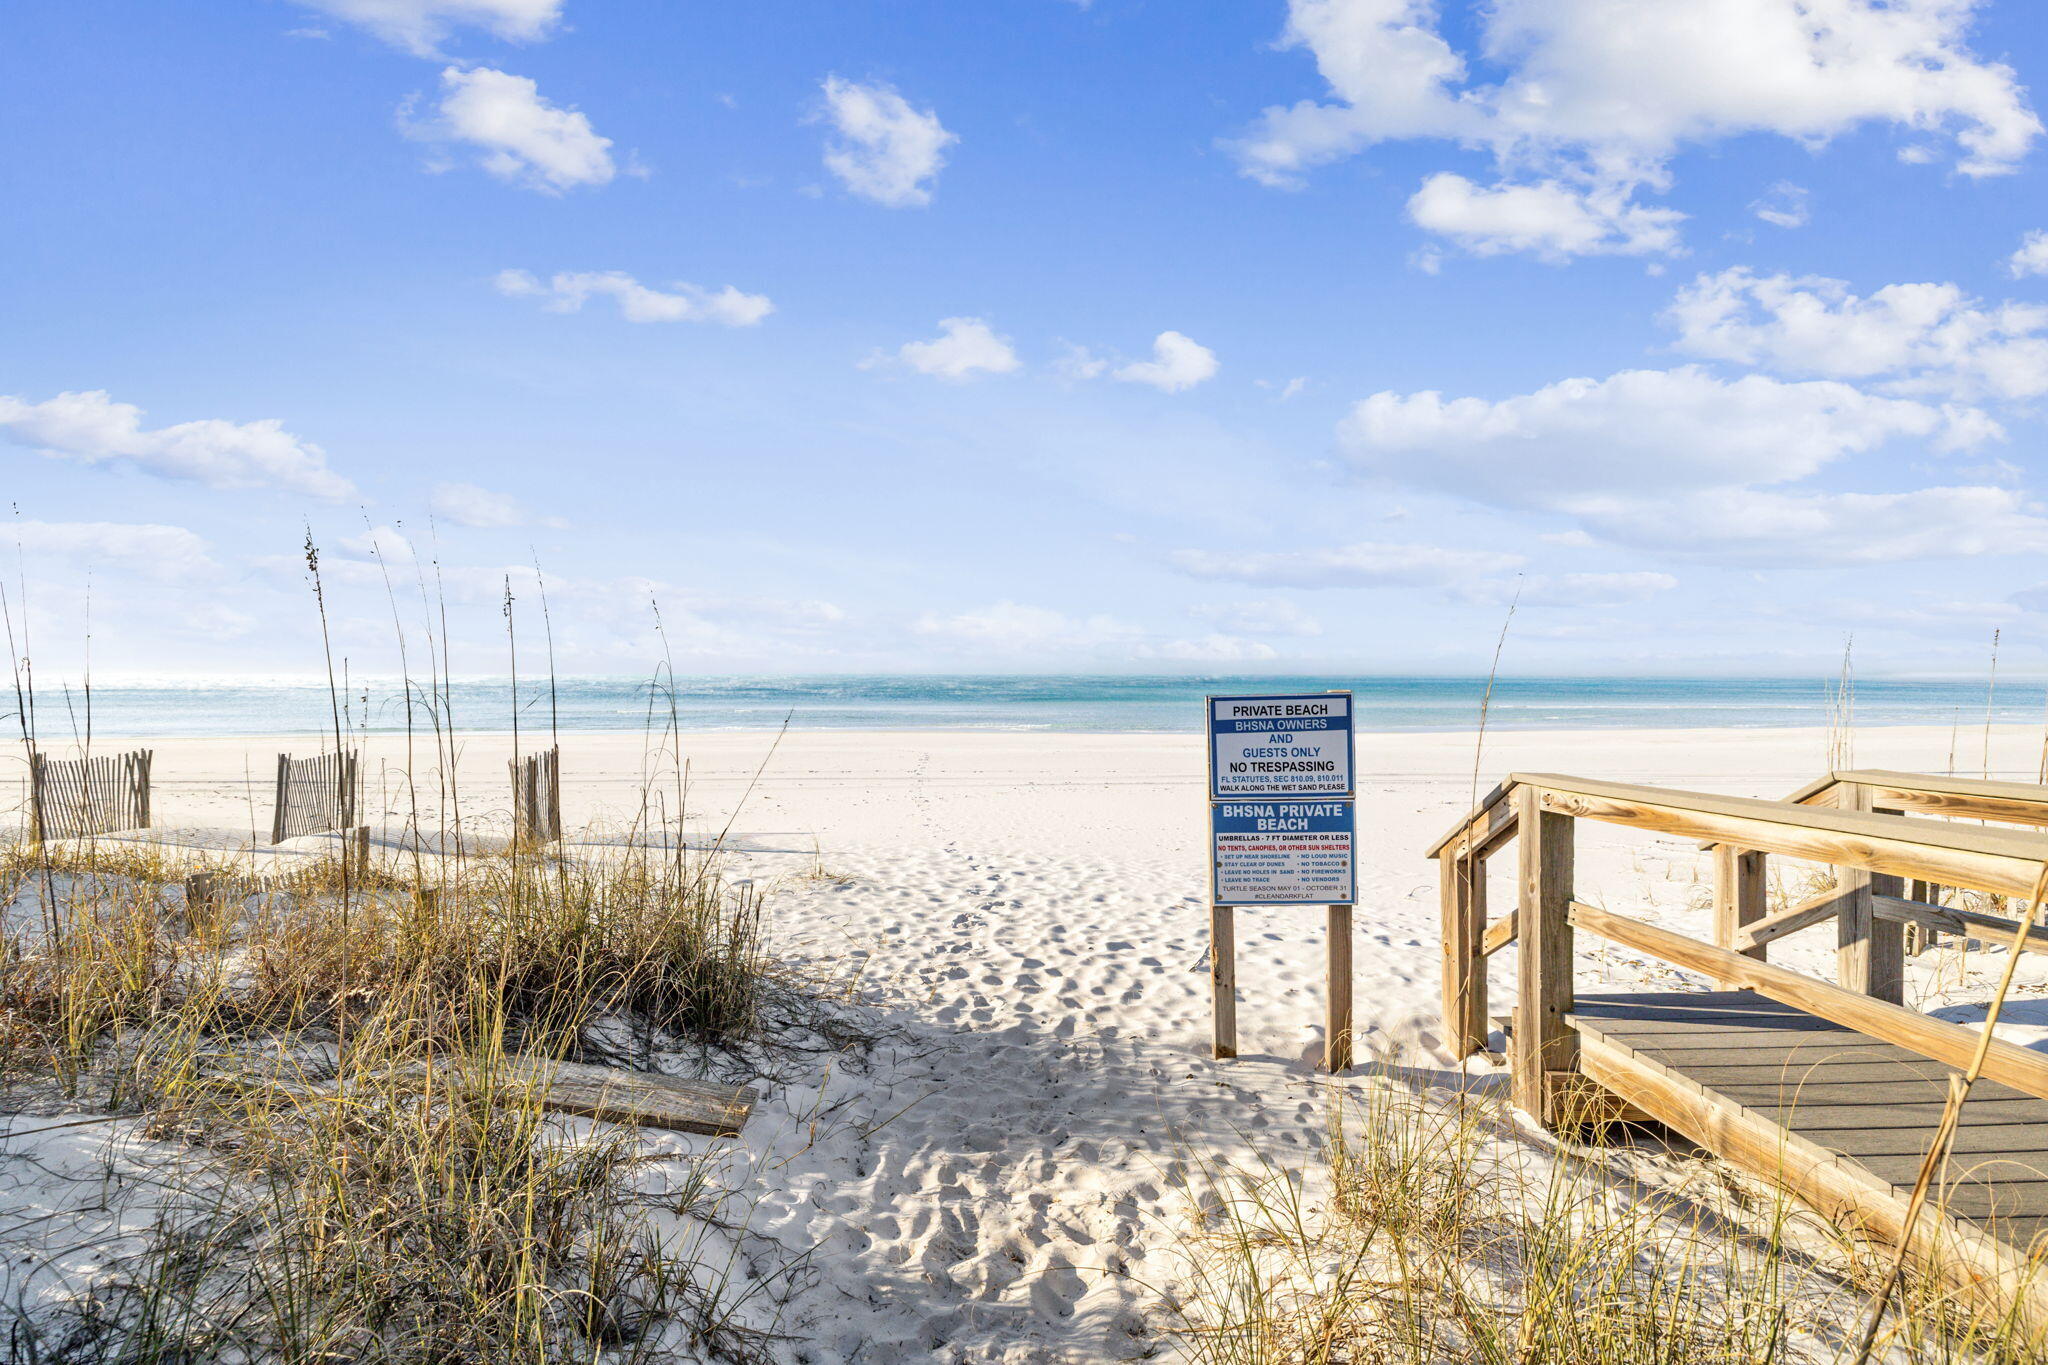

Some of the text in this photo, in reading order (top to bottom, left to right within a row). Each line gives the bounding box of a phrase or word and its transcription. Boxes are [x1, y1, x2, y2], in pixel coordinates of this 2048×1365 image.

[1234, 705, 1328, 716] PRIVATE BEACH
[1236, 719, 1327, 731] BHSNA OWNERS
[1269, 734, 1293, 743] AND
[1243, 747, 1320, 758] GUESTS ONLY
[1230, 761, 1334, 772] NO TRESPASSING
[1223, 804, 1342, 817] BHSNA PRIVATE
[1258, 818, 1308, 830] BEACH
